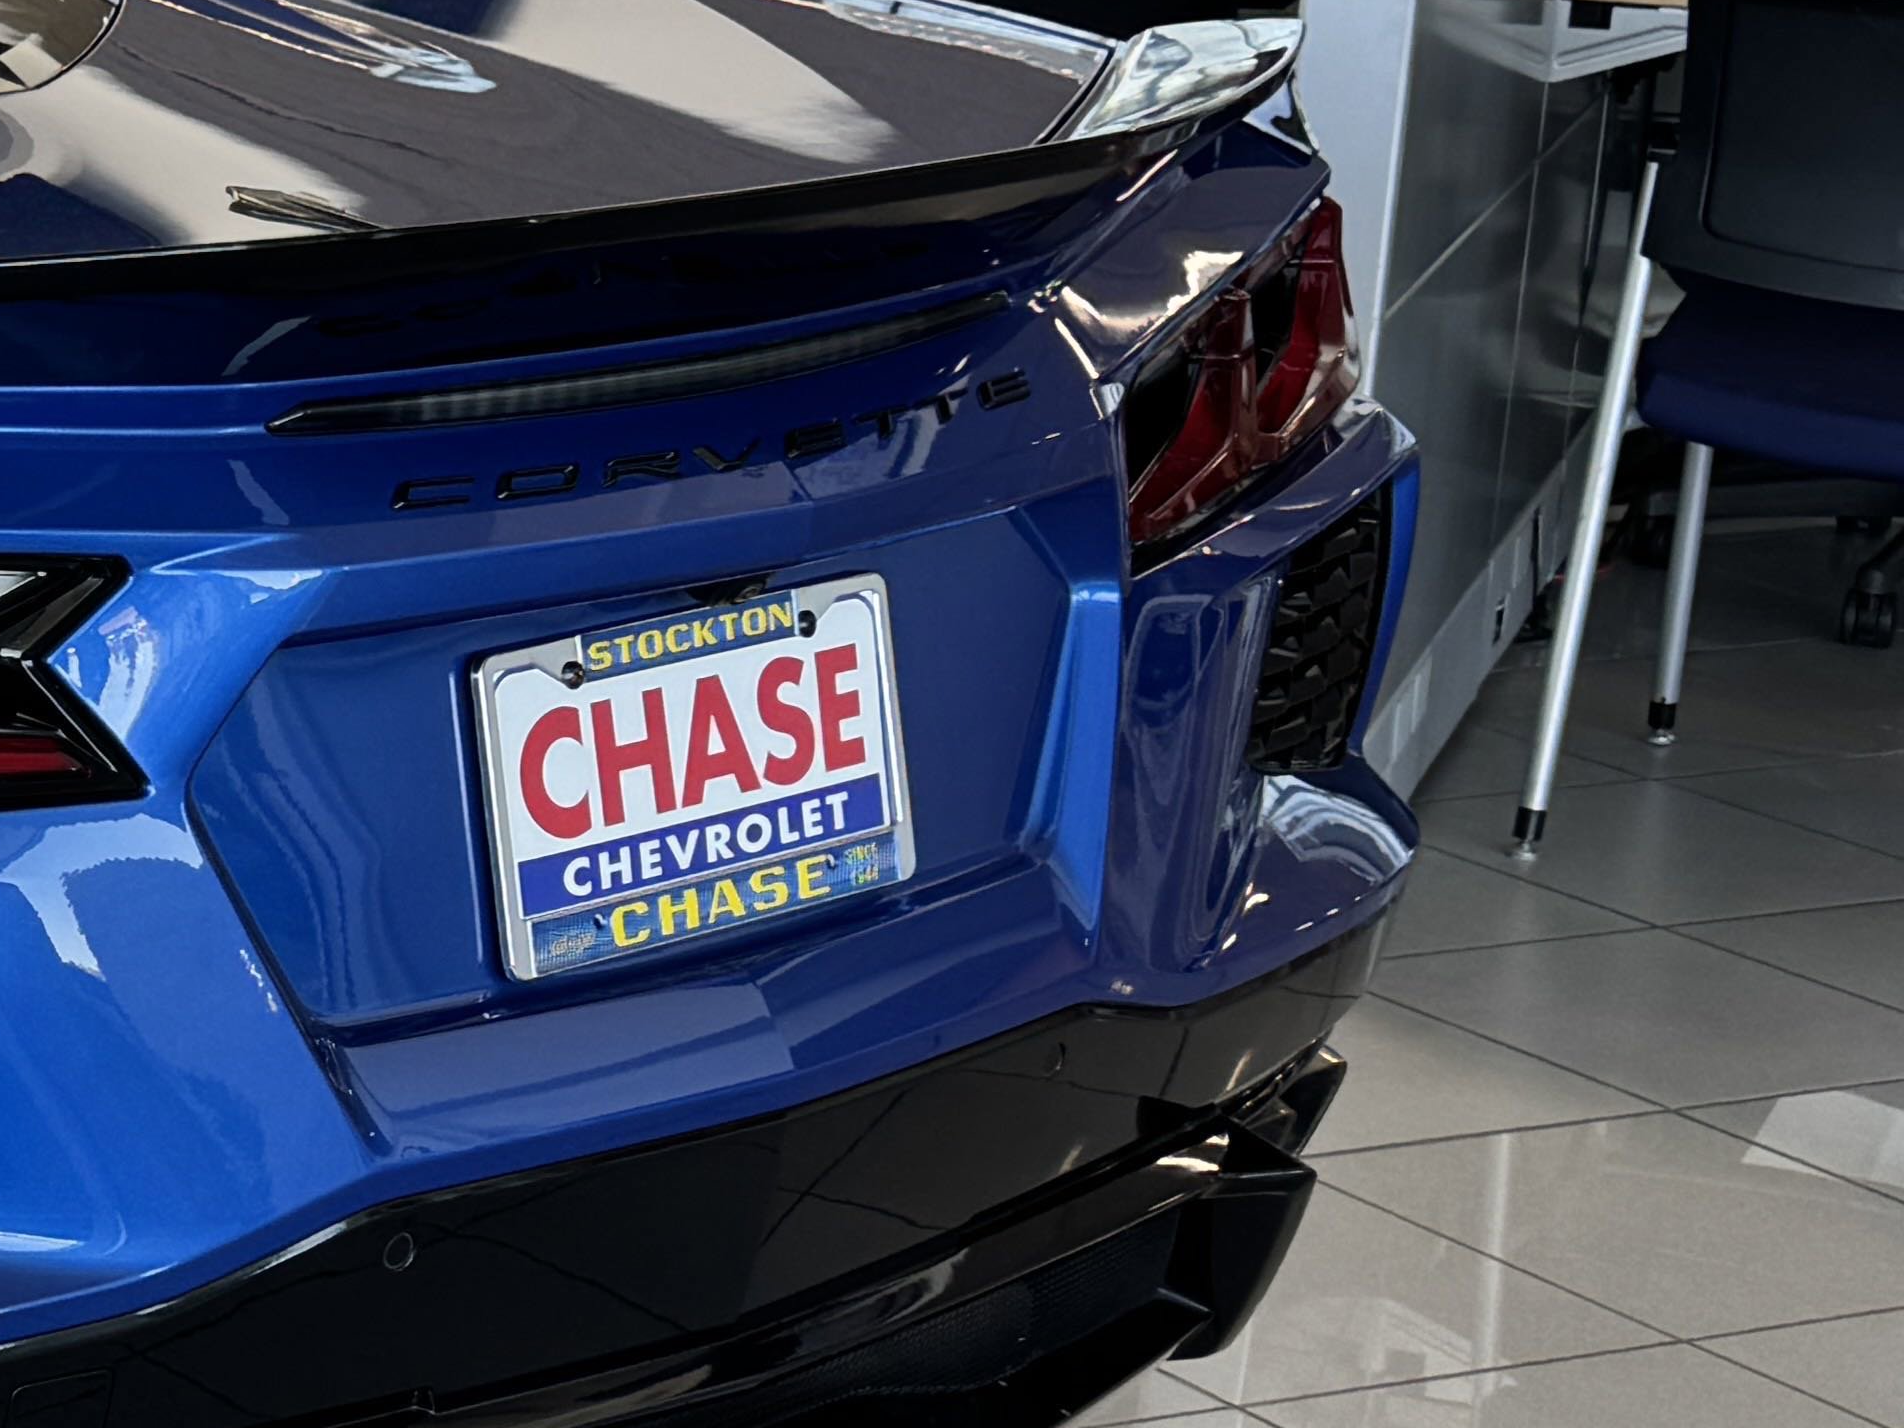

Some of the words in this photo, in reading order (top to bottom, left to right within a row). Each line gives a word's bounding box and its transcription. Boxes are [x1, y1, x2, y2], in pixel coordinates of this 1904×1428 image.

[391, 367, 1032, 511] CORVETTE
[586, 600, 793, 672] STOCKTON
[519, 642, 867, 840] CHASE
[562, 790, 849, 897] CHEVROLET
[609, 853, 832, 948] CHASE
